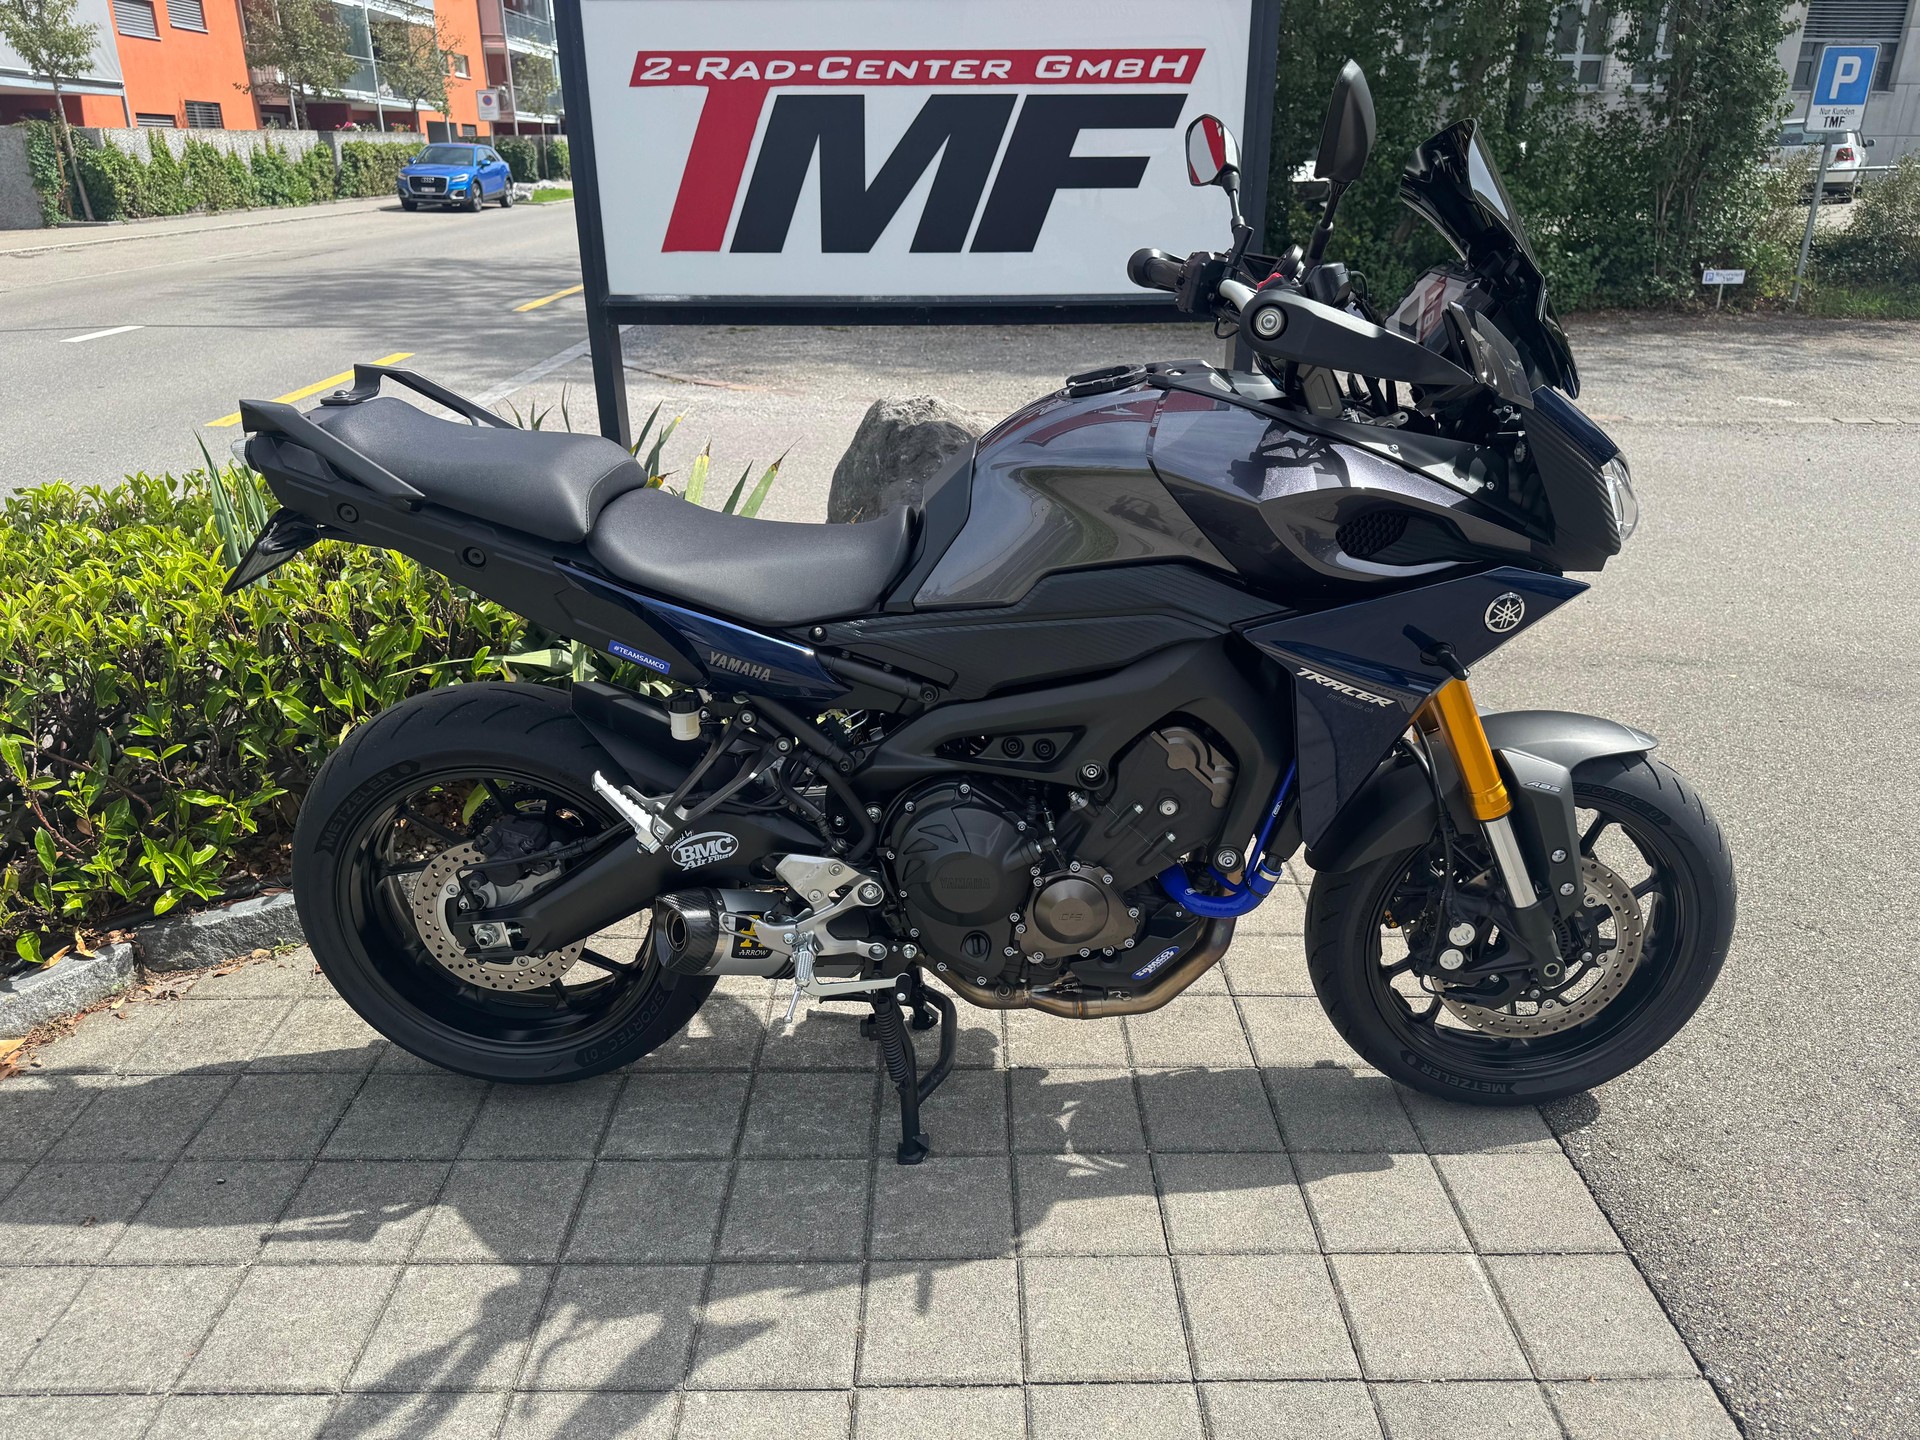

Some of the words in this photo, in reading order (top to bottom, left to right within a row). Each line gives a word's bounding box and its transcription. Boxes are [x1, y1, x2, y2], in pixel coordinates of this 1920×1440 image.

[1829, 56, 1862, 99] P
[1820, 107, 1831, 115] Nur
[1831, 107, 1855, 115] Kunden
[1823, 116, 1846, 128] TMF
[657, 88, 1189, 254] TMF
[613, 645, 665, 670] #TEAMSAMCO
[709, 651, 771, 681] YAMAHA
[1296, 667, 1396, 708] TRACER
[1327, 693, 1374, 713] tmf-honda.ch
[1525, 781, 1562, 793] ABS
[321, 772, 396, 848] METZELER
[664, 834, 686, 852] Powered
[678, 837, 732, 863] BMC
[681, 857, 707, 871] Air
[707, 853, 731, 864] Filter
[607, 991, 664, 1050] SPORTEC
[583, 1048, 599, 1063] 01
[1420, 1062, 1506, 1093] METZELER
